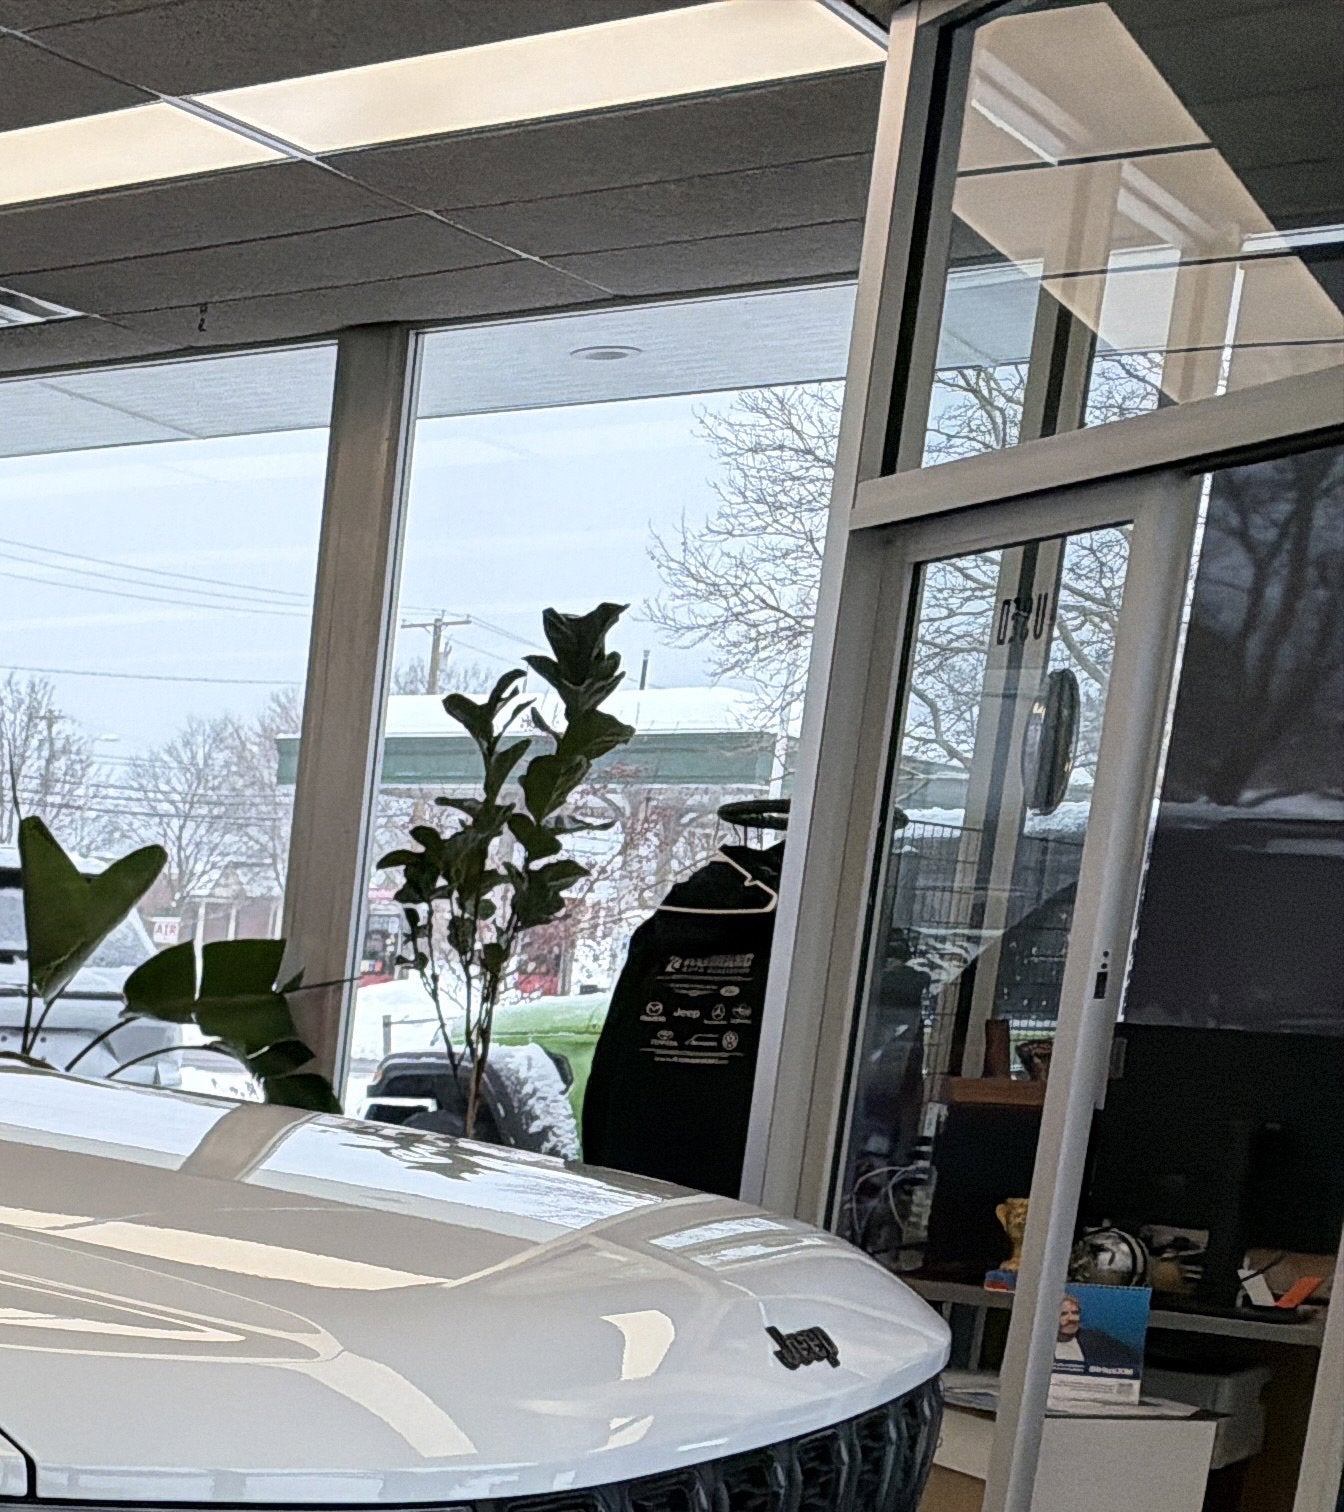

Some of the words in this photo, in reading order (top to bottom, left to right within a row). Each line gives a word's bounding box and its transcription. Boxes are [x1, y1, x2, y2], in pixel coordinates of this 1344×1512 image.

[155, 923, 177, 936] AIR
[673, 1007, 701, 1019] Jeep
[765, 1325, 841, 1371] Jeep
